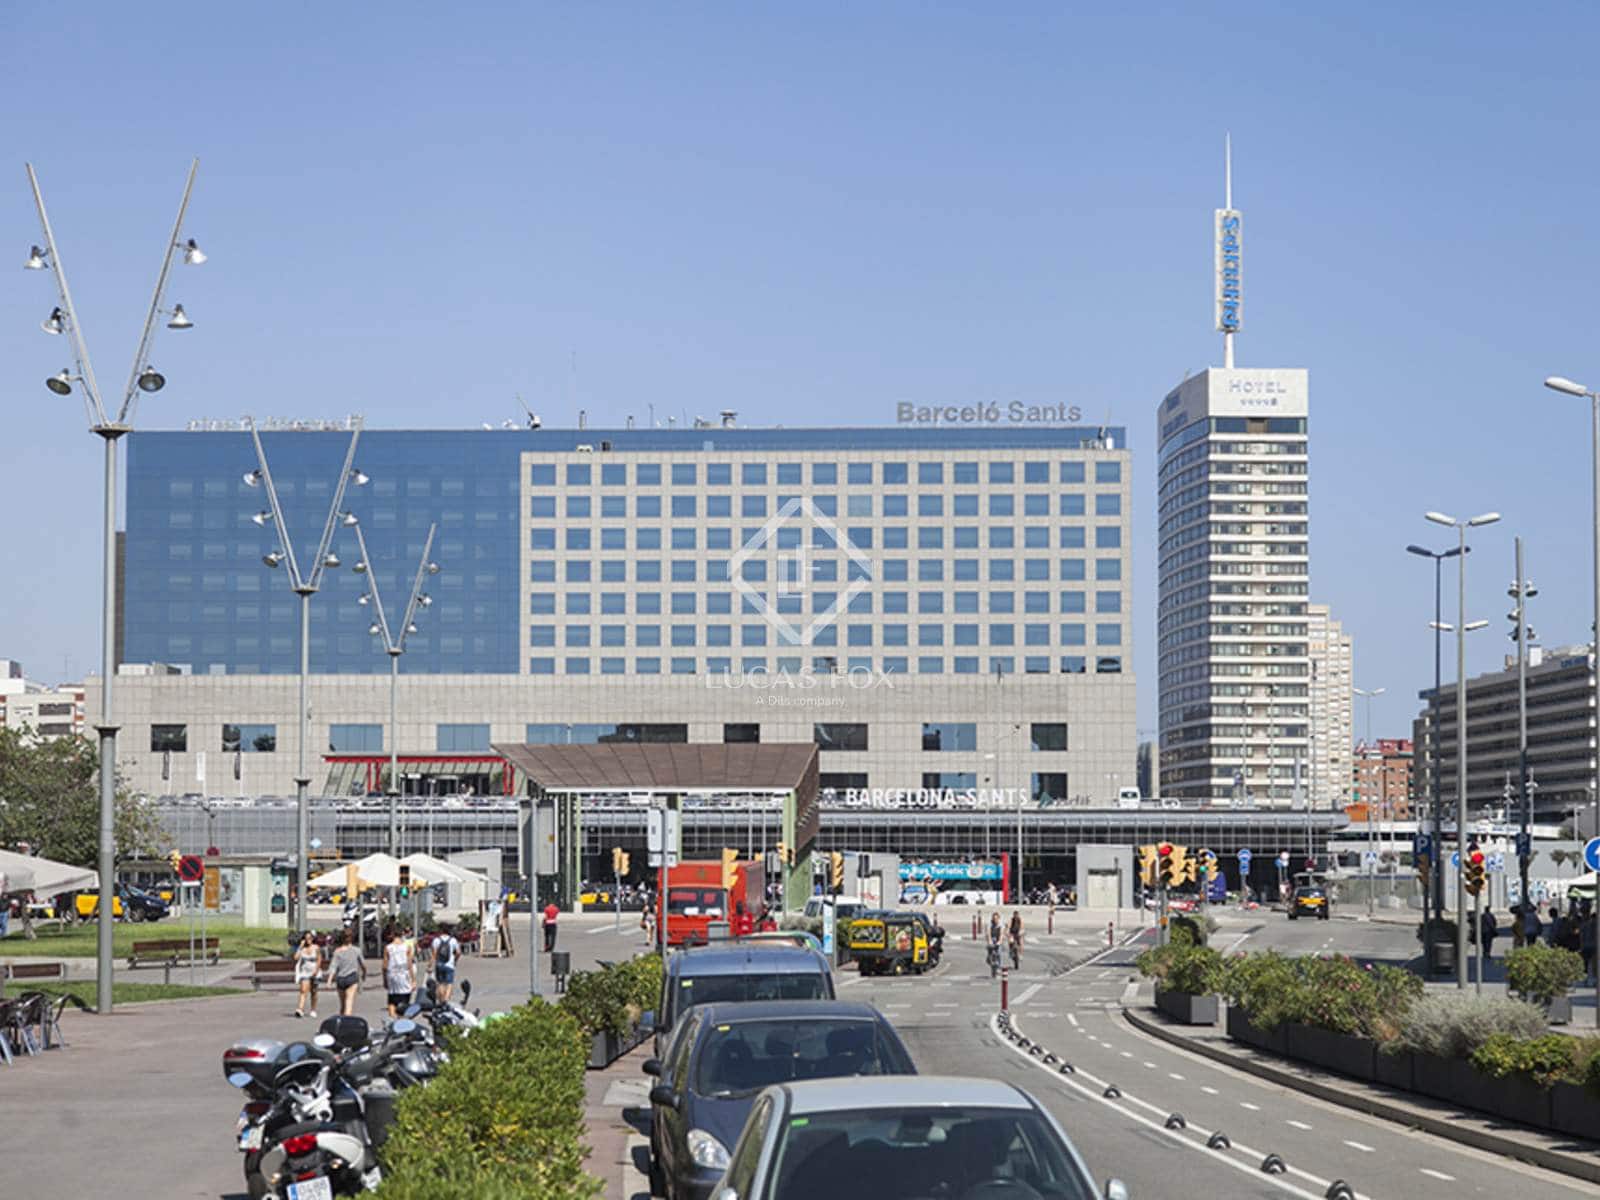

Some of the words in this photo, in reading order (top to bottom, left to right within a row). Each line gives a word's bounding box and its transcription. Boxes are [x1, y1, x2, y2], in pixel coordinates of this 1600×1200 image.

[1229, 380, 1286, 393] HOTEL
[897, 400, 999, 423] Barceló
[1007, 400, 1081, 423] Sants
[1416, 836, 1428, 852] P
